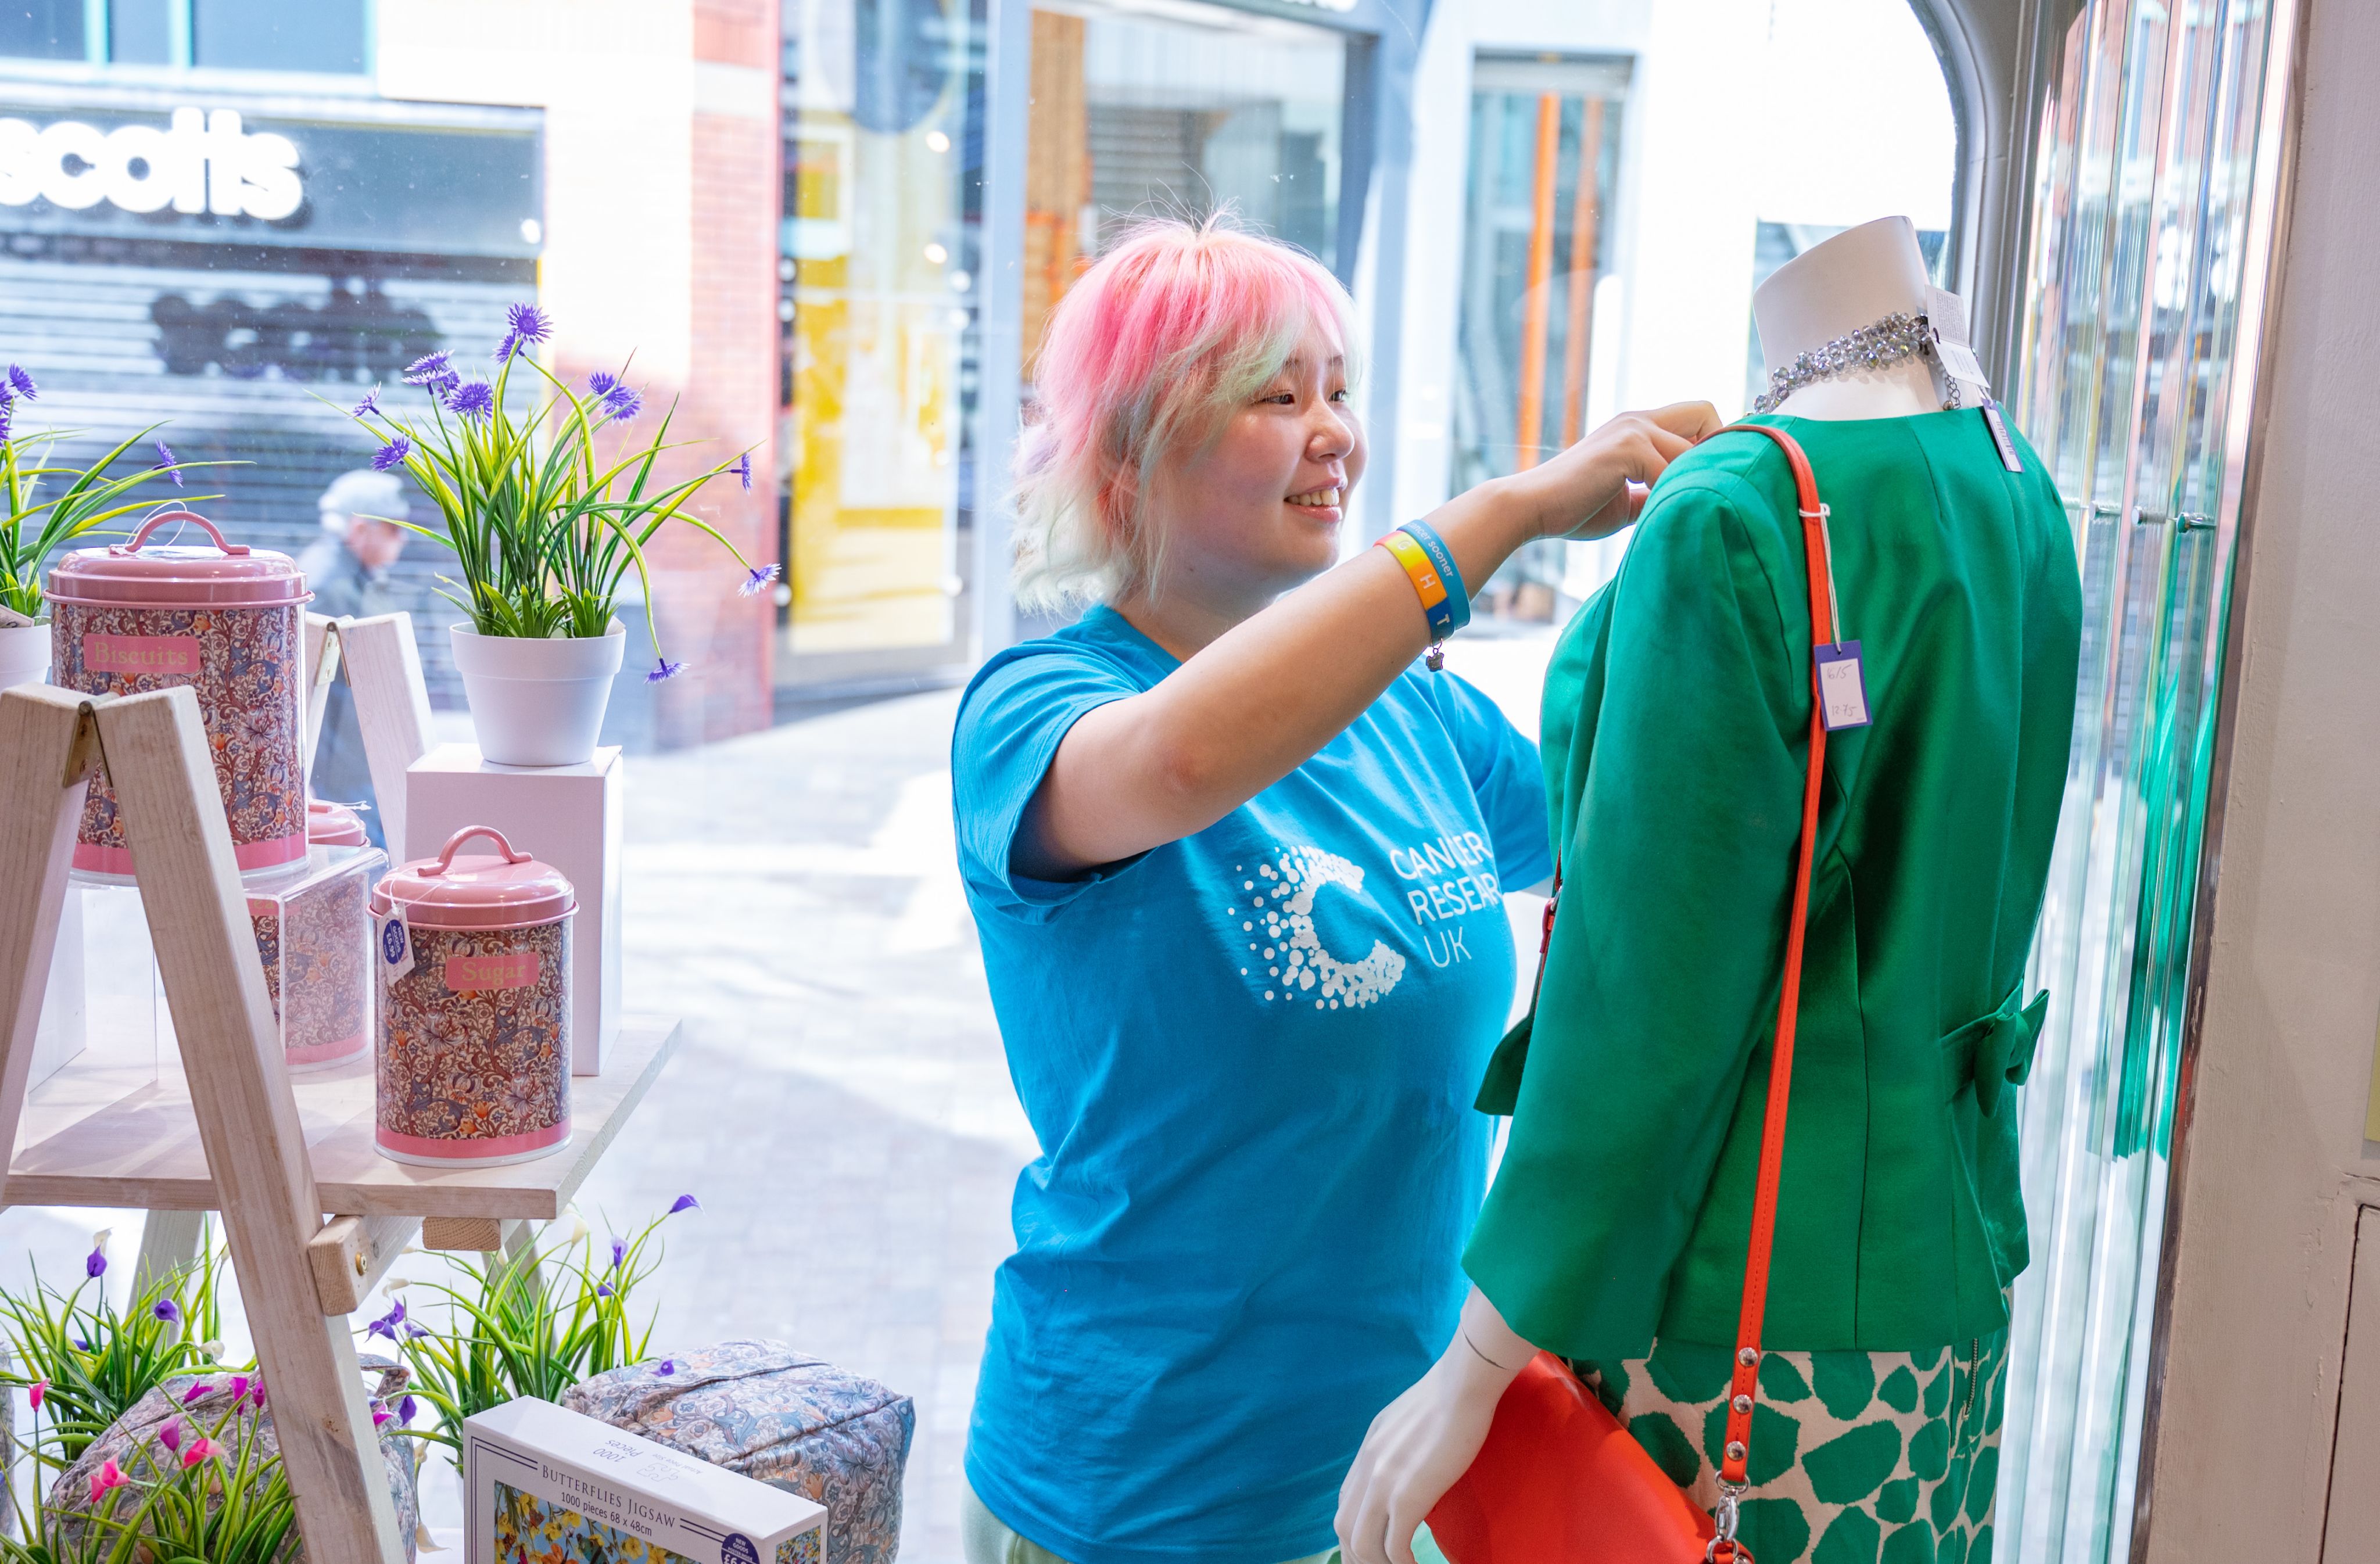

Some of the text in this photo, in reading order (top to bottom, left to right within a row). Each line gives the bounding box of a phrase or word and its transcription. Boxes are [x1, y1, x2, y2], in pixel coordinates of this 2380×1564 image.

[0, 106, 304, 220] scotts
[1407, 523, 1453, 577] cancer sooner
[94, 641, 188, 666] Biscuits
[386, 932, 396, 957] £6.99
[392, 926, 401, 953] GOODS
[1424, 926, 1472, 968] UK
[461, 962, 526, 986] Sugar
[593, 1448, 626, 1462] 1000
[543, 1465, 676, 1528] BUTTERFLIES JIGSAW
[561, 1492, 652, 1537] 1000 pieces 68 x 48cm
[733, 1543, 748, 1554] GOODS
[736, 1538, 746, 1547] NEW
